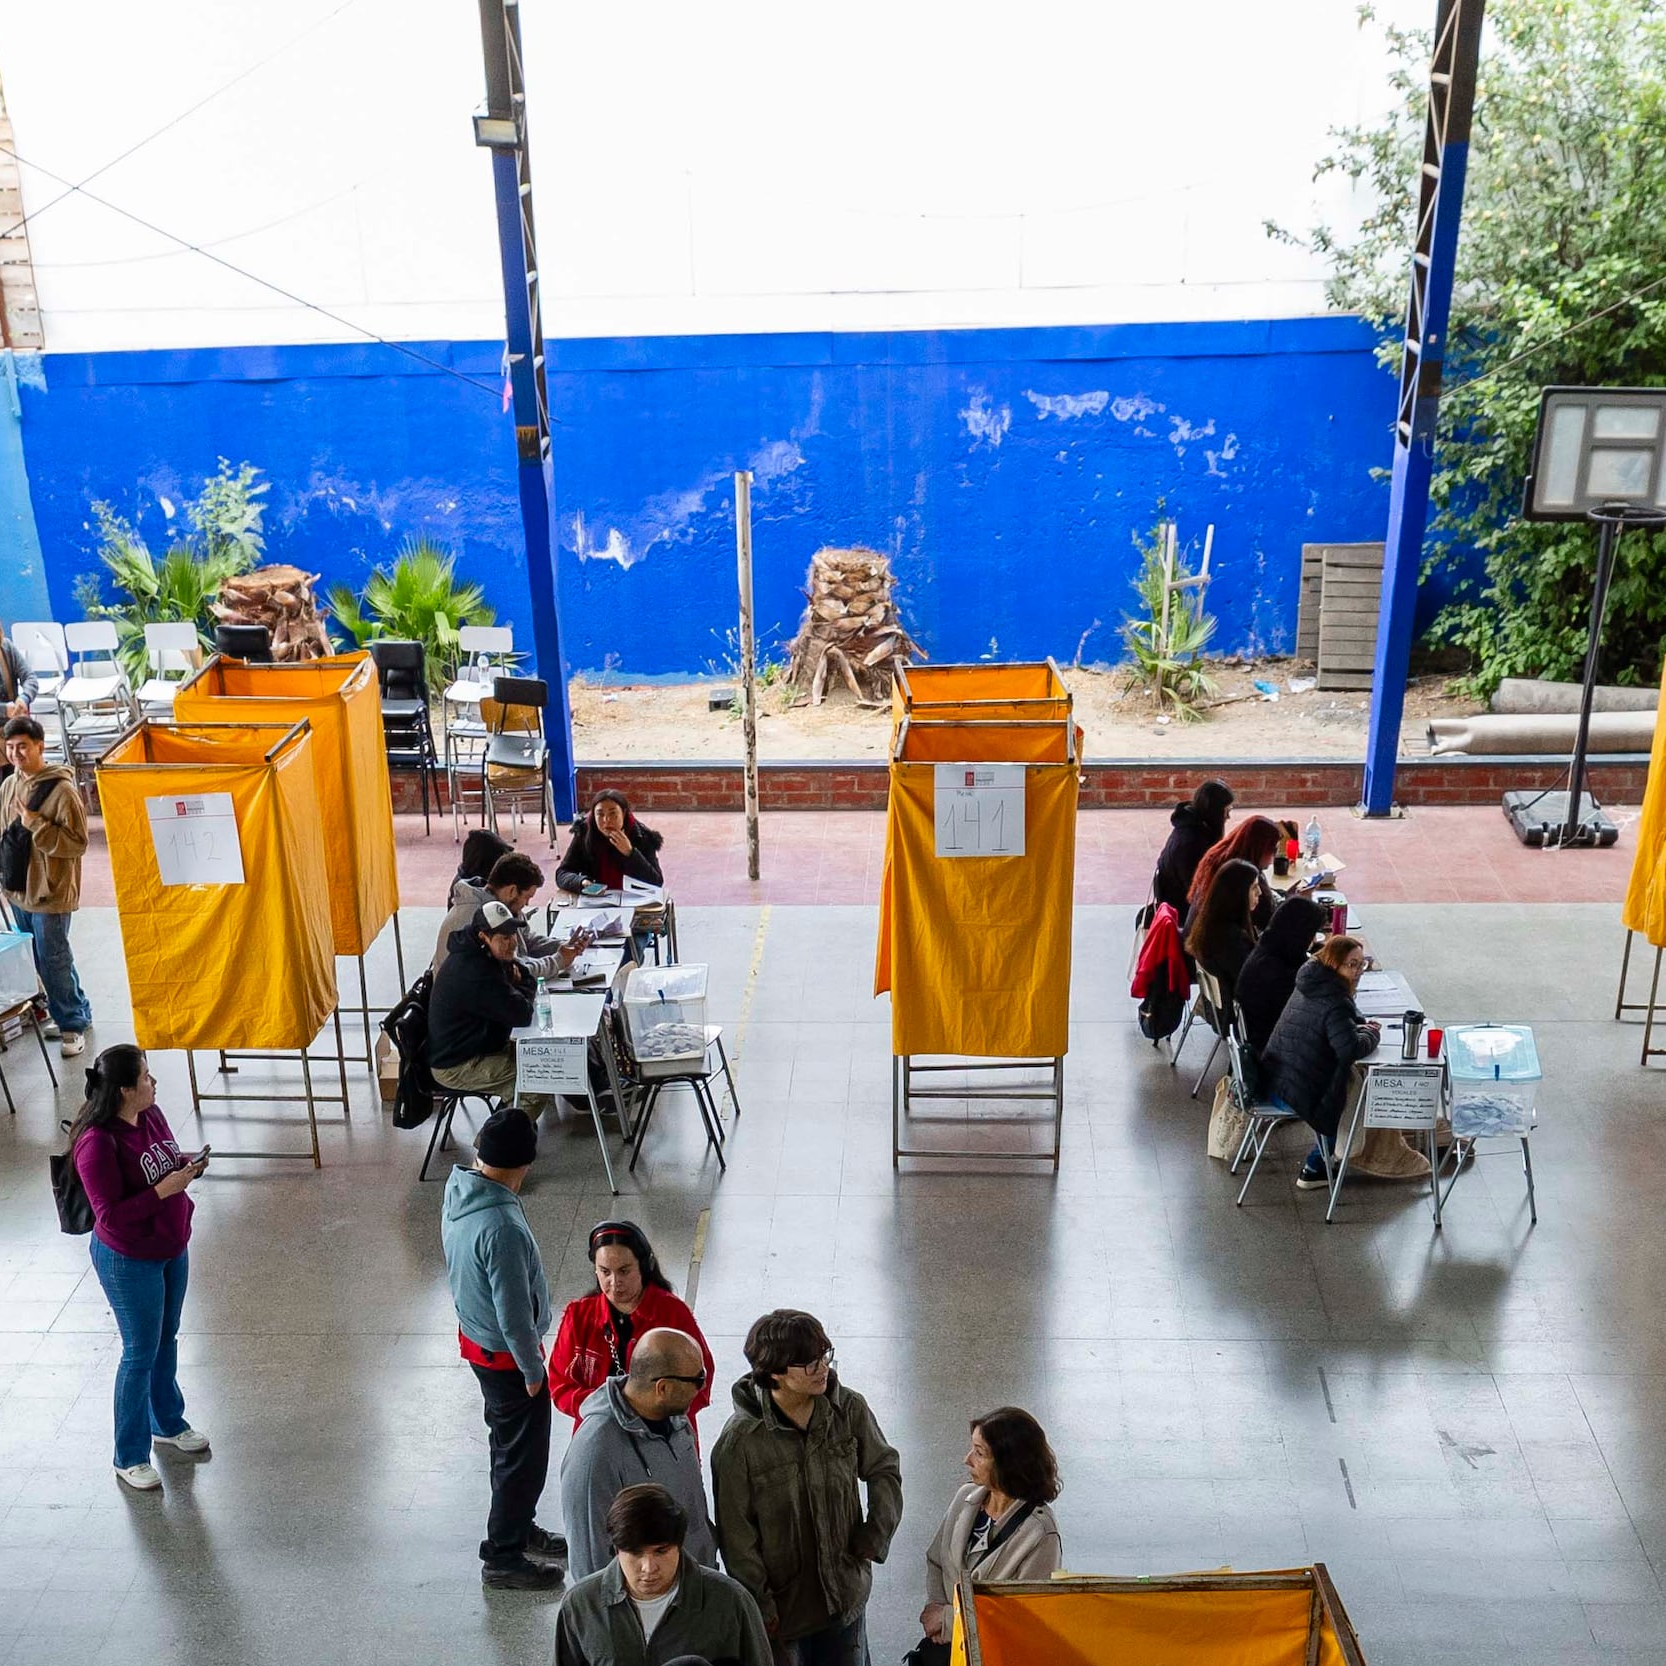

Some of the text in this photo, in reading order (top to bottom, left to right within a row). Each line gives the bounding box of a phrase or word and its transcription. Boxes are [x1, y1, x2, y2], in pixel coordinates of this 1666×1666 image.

[942, 799, 1010, 851] 141
[166, 831, 221, 869] 142
[140, 1140, 181, 1185] GAP
